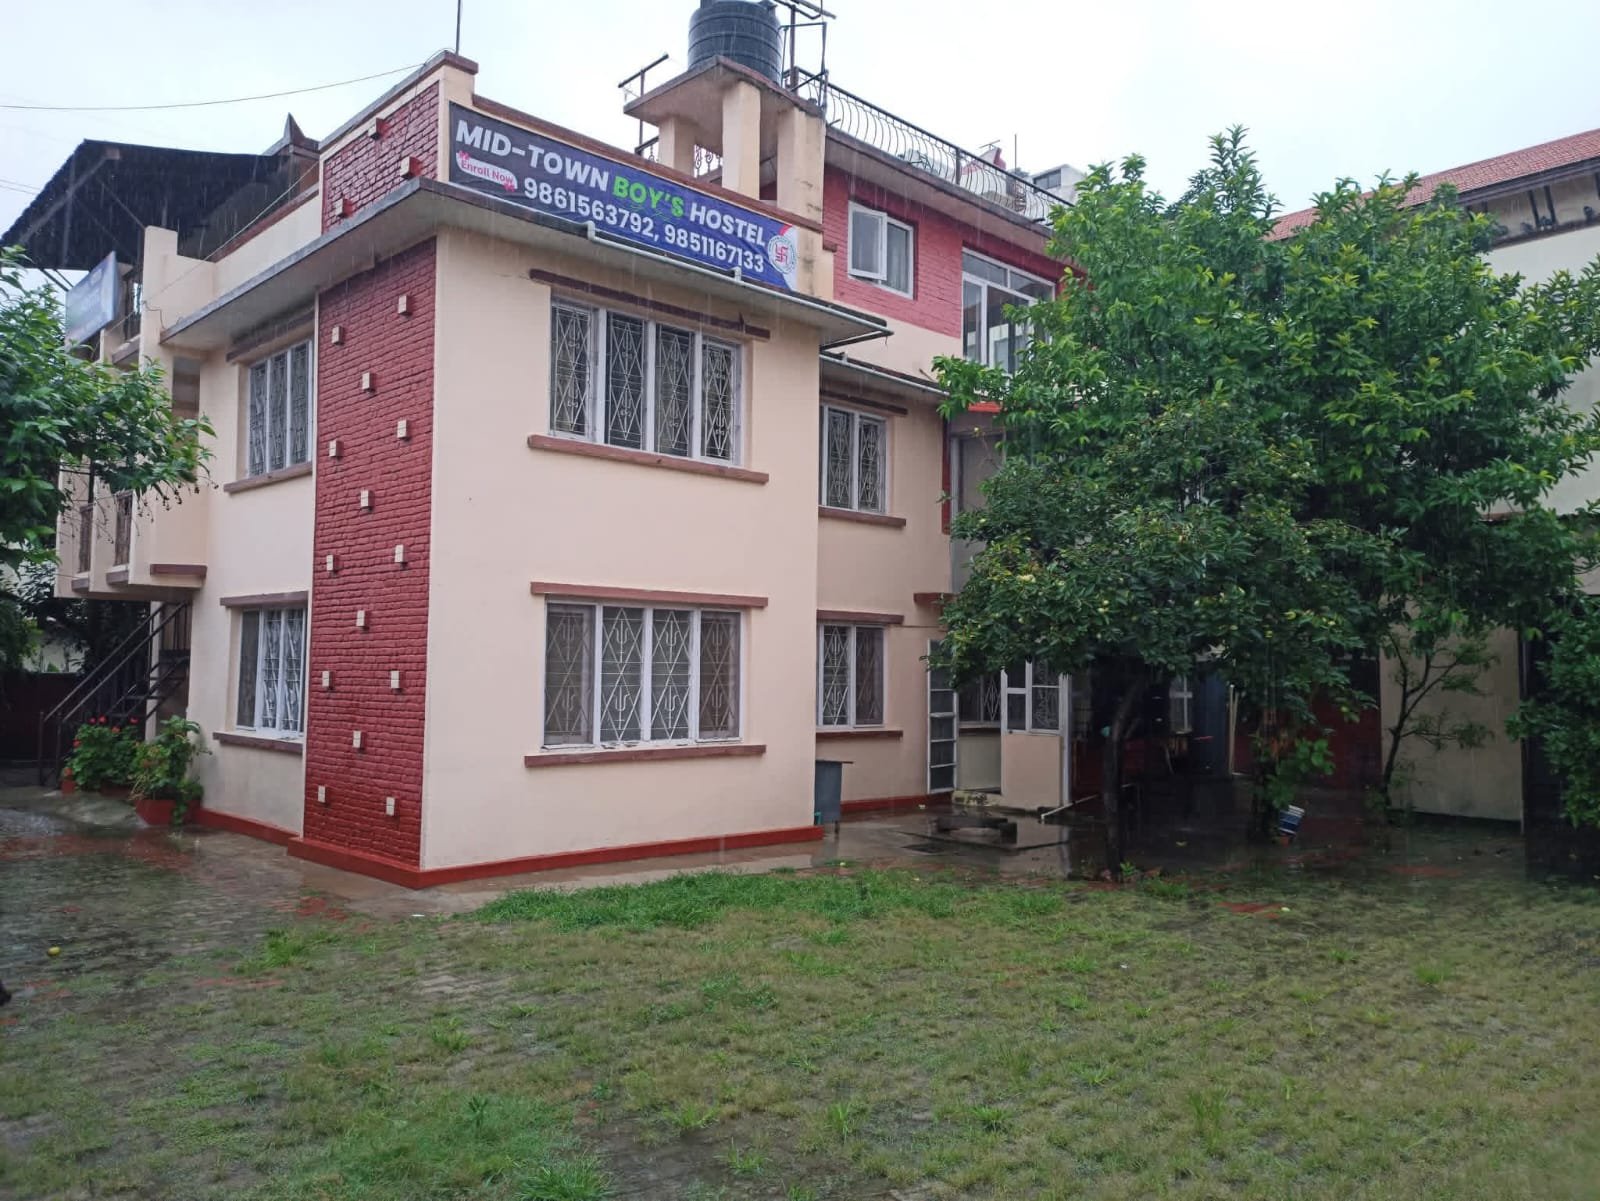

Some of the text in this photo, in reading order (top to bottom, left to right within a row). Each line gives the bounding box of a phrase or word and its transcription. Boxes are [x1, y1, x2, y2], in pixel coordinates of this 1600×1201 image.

[455, 119, 766, 247] MID-TOWN BOY'S HOSTEL
[461, 160, 514, 184] Enroll Now
[524, 177, 660, 242] 9861563792,
[664, 224, 764, 273] 9851167133
